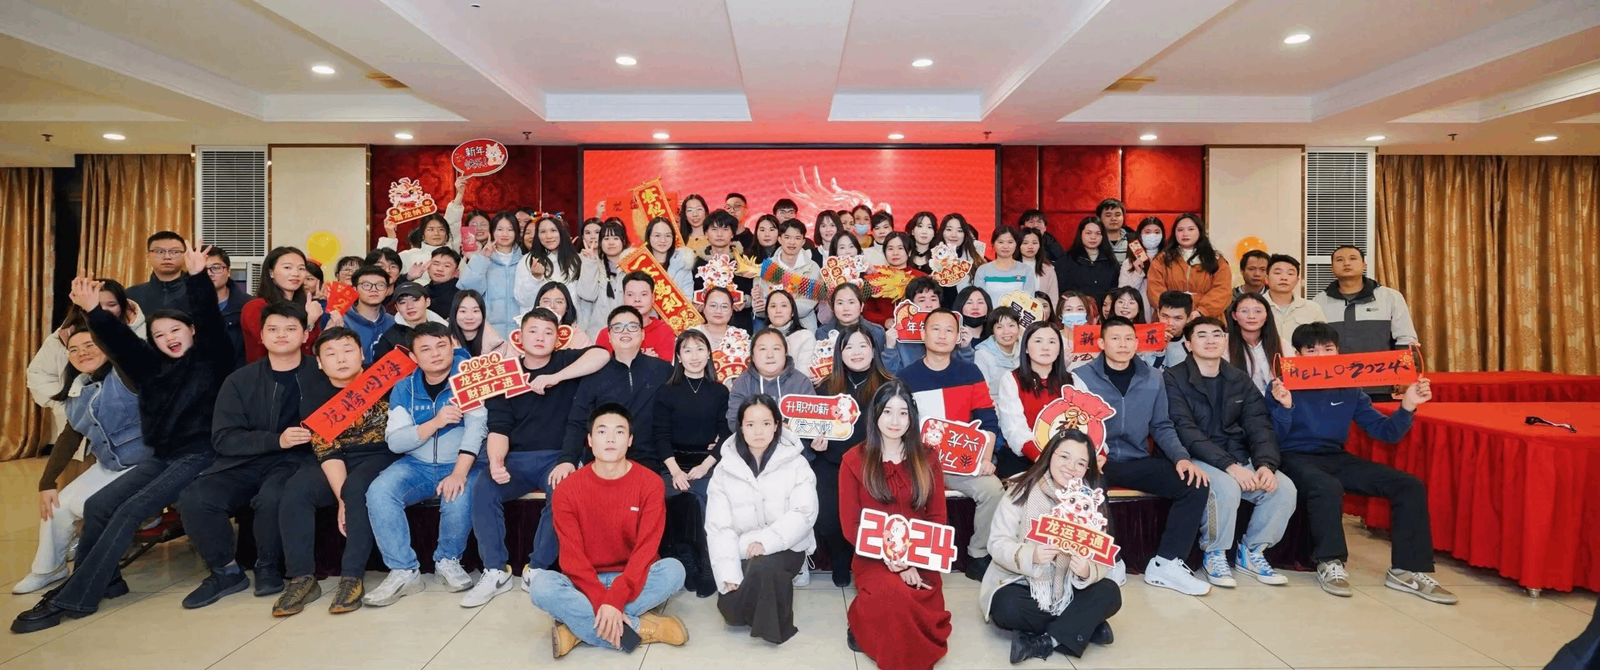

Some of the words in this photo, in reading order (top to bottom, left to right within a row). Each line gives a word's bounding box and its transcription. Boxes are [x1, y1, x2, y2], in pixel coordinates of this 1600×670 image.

[465, 146, 485, 157] 新年
[461, 354, 500, 373] 2024
[1289, 364, 1345, 380] HELLO
[1348, 360, 1410, 379] 2024
[460, 364, 506, 387] 龙年大吉
[467, 376, 514, 399] 财源广进
[786, 401, 829, 415] 升职加薪
[795, 419, 834, 434] 发大财
[859, 512, 955, 570] 2024
[1045, 519, 1105, 549] 龙运亨通
